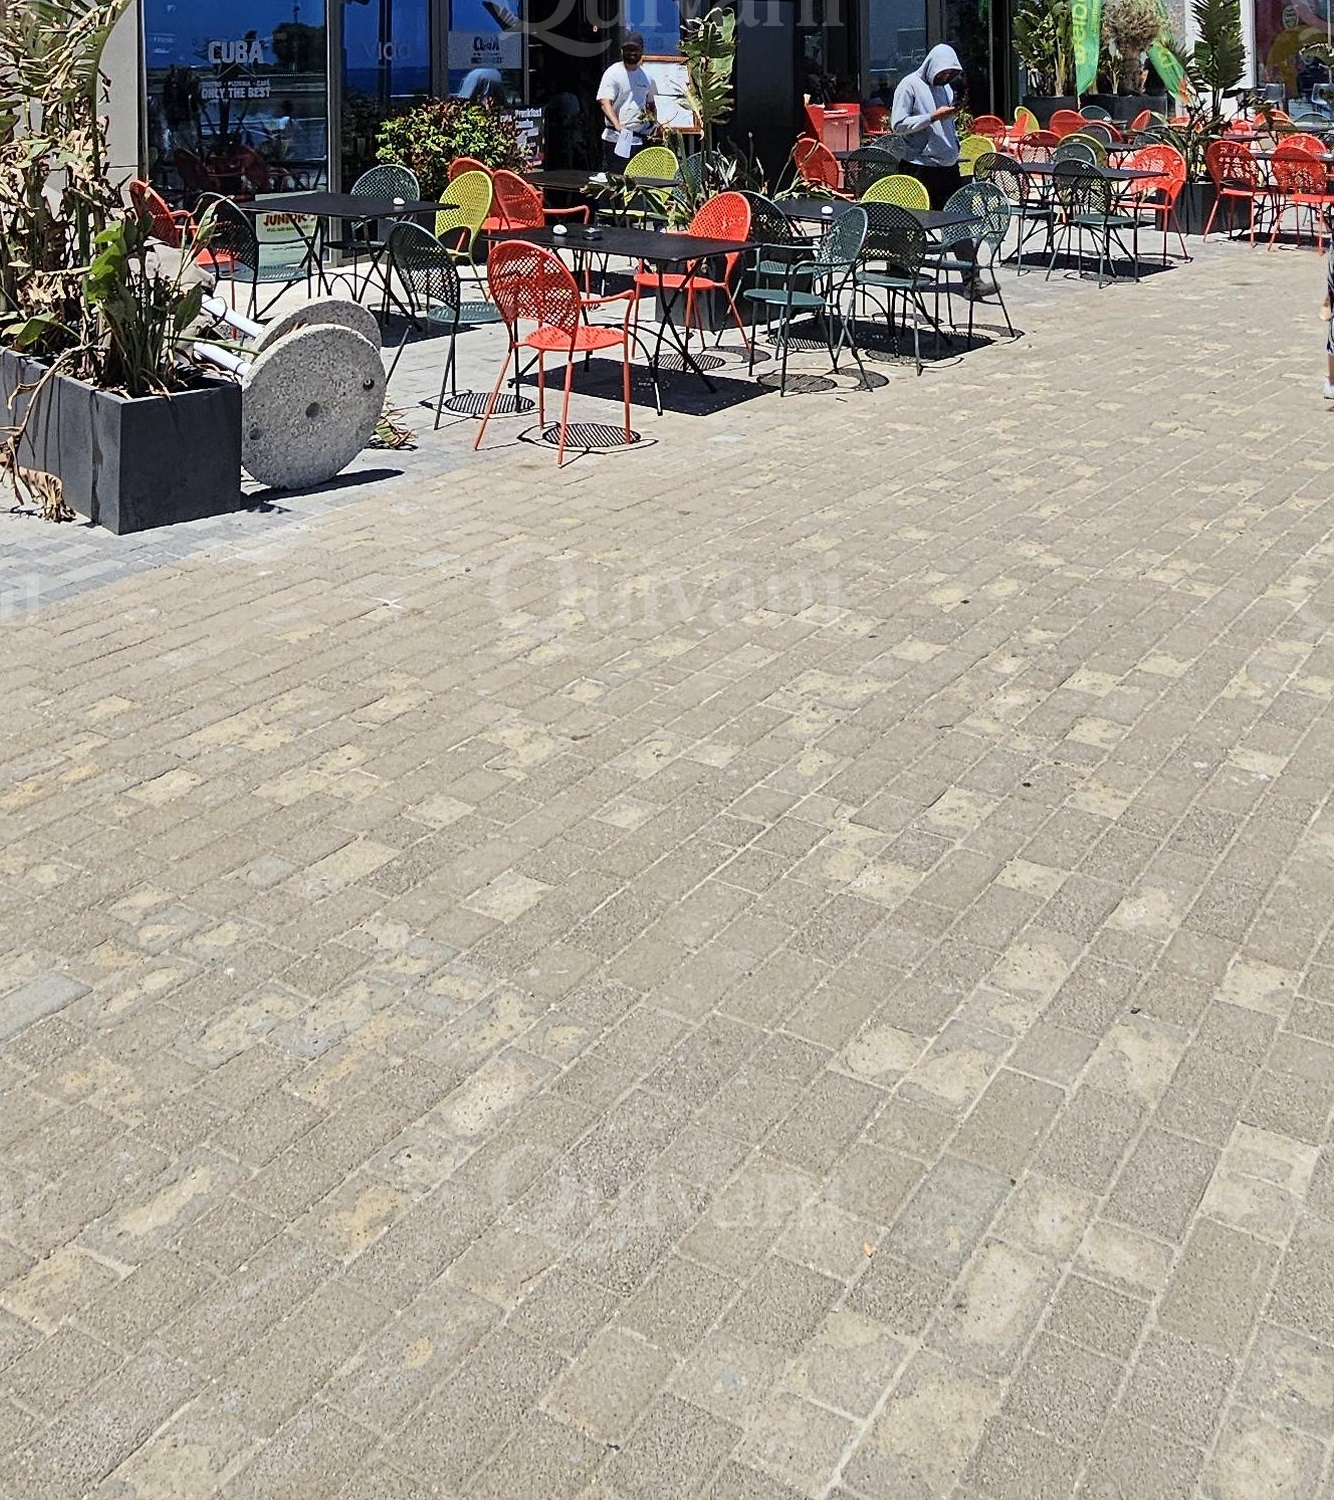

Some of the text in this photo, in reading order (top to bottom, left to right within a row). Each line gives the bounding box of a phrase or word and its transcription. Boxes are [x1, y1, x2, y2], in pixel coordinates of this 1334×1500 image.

[208, 41, 264, 64] CUBA
[201, 87, 272, 99] ONLY THE BEST
